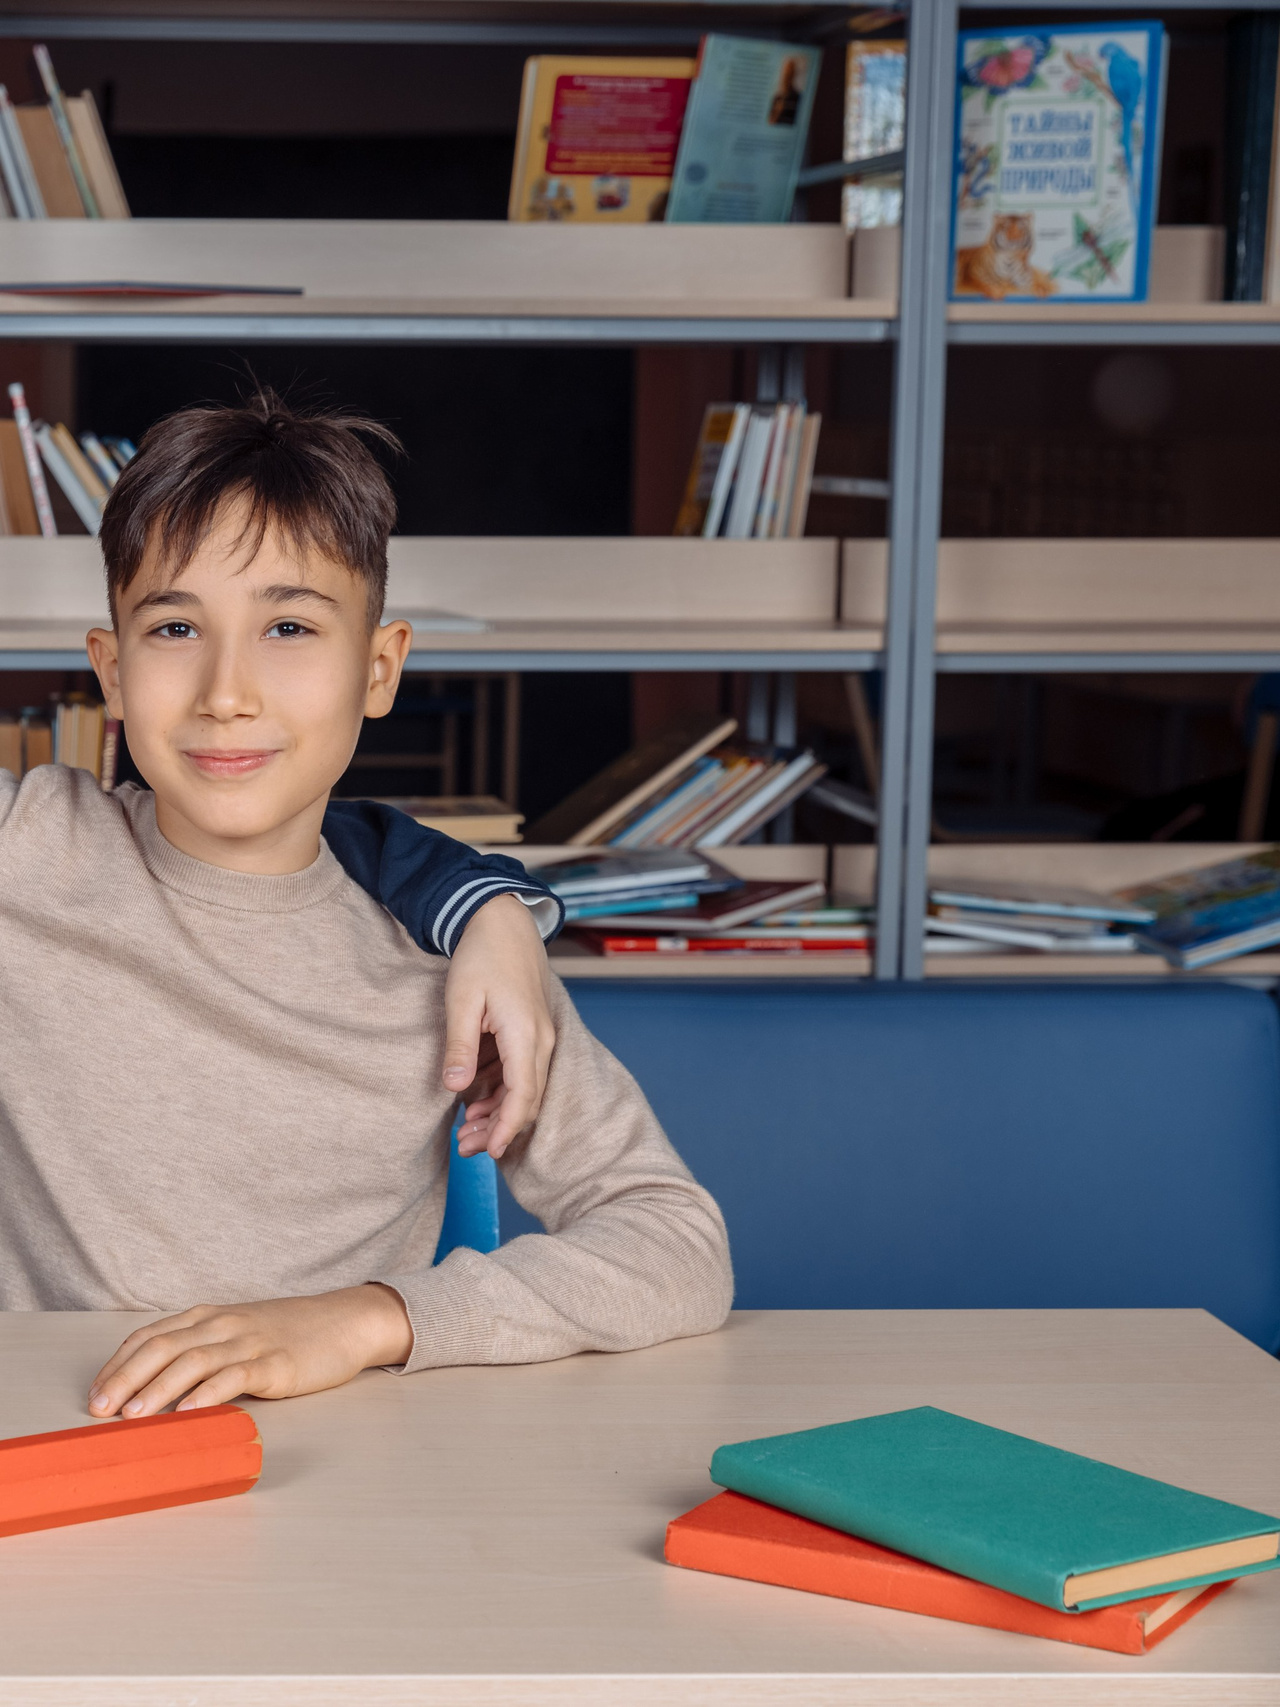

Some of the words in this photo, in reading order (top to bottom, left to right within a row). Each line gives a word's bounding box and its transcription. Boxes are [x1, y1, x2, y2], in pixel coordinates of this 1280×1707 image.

[1009, 110, 1094, 134] ТАЙНЫ
[1008, 136, 1092, 161] ЖИВОЙ
[1001, 165, 1097, 195] ПРИРОДЫ
